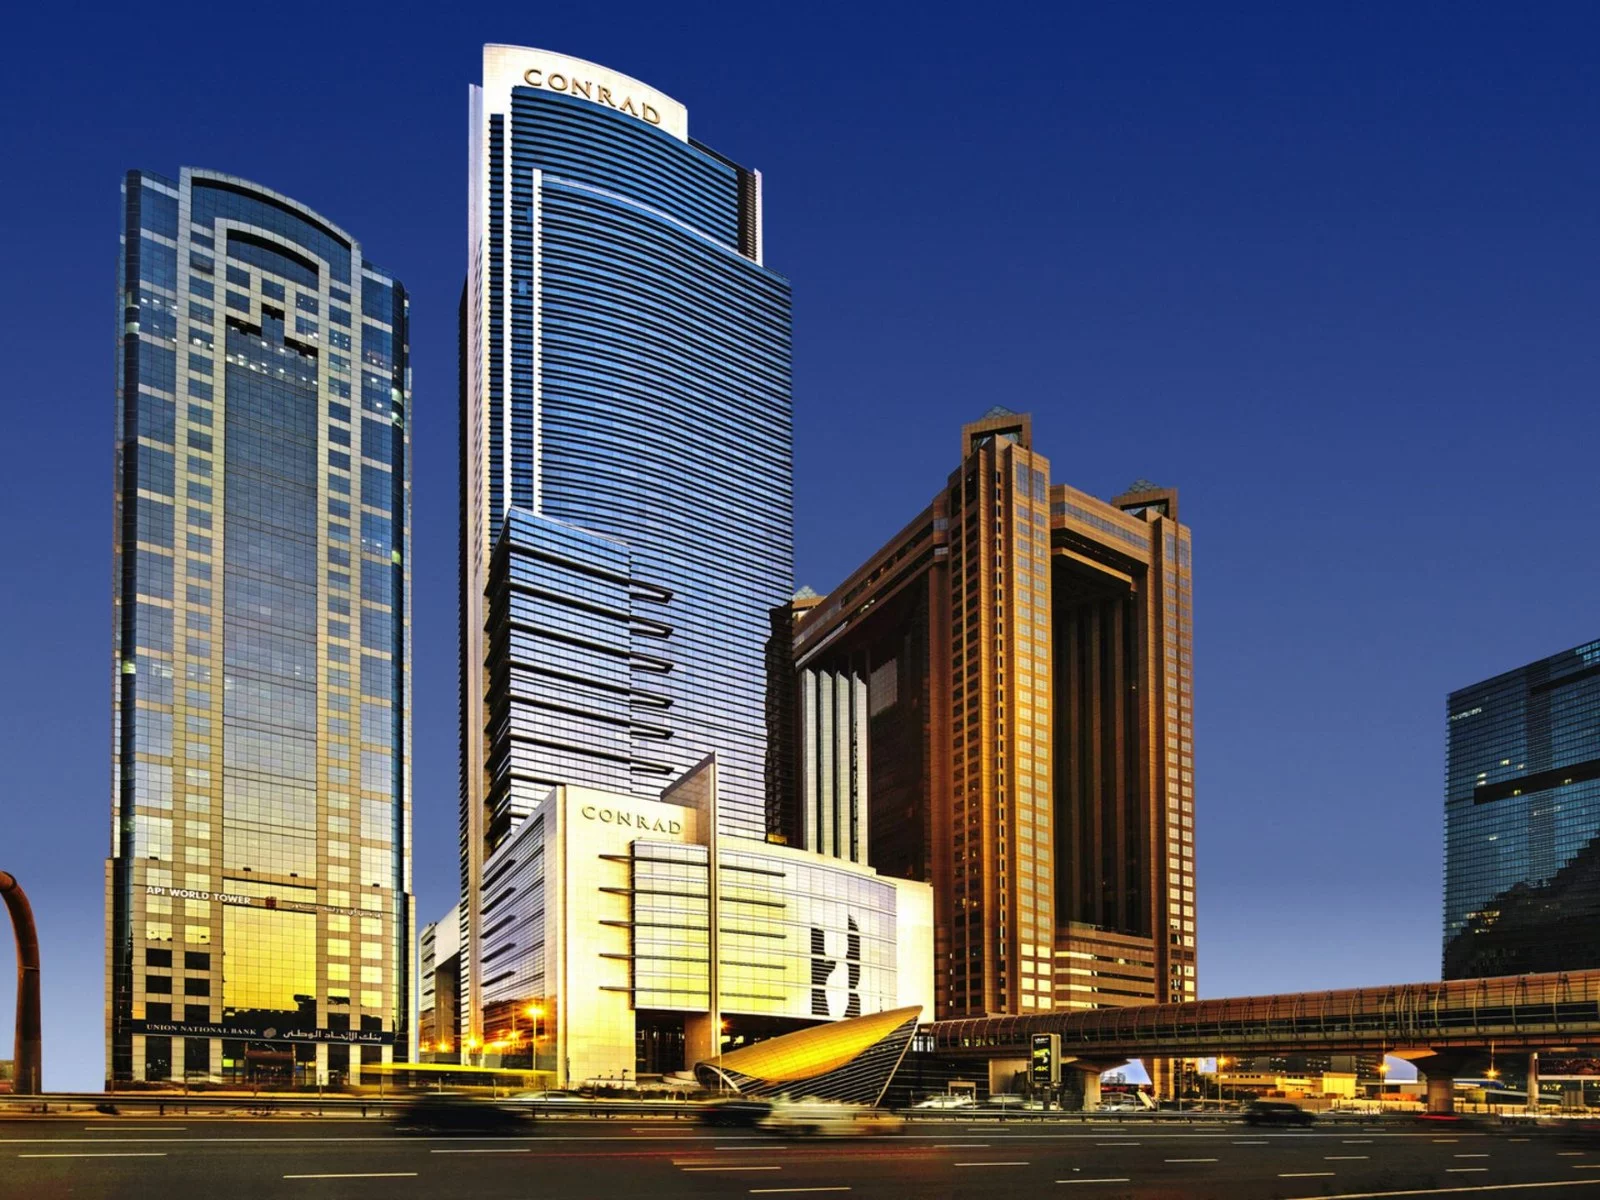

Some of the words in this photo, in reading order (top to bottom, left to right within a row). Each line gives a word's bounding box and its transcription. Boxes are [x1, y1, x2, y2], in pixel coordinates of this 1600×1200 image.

[523, 68, 661, 125] CONRAD
[581, 806, 681, 835] CONRAD
[146, 886, 165, 895] API
[169, 888, 209, 900] WORLD
[213, 893, 251, 904] TOWER
[180, 1025, 229, 1034] NATIONAL
[359, 1032, 382, 1042] بنك
